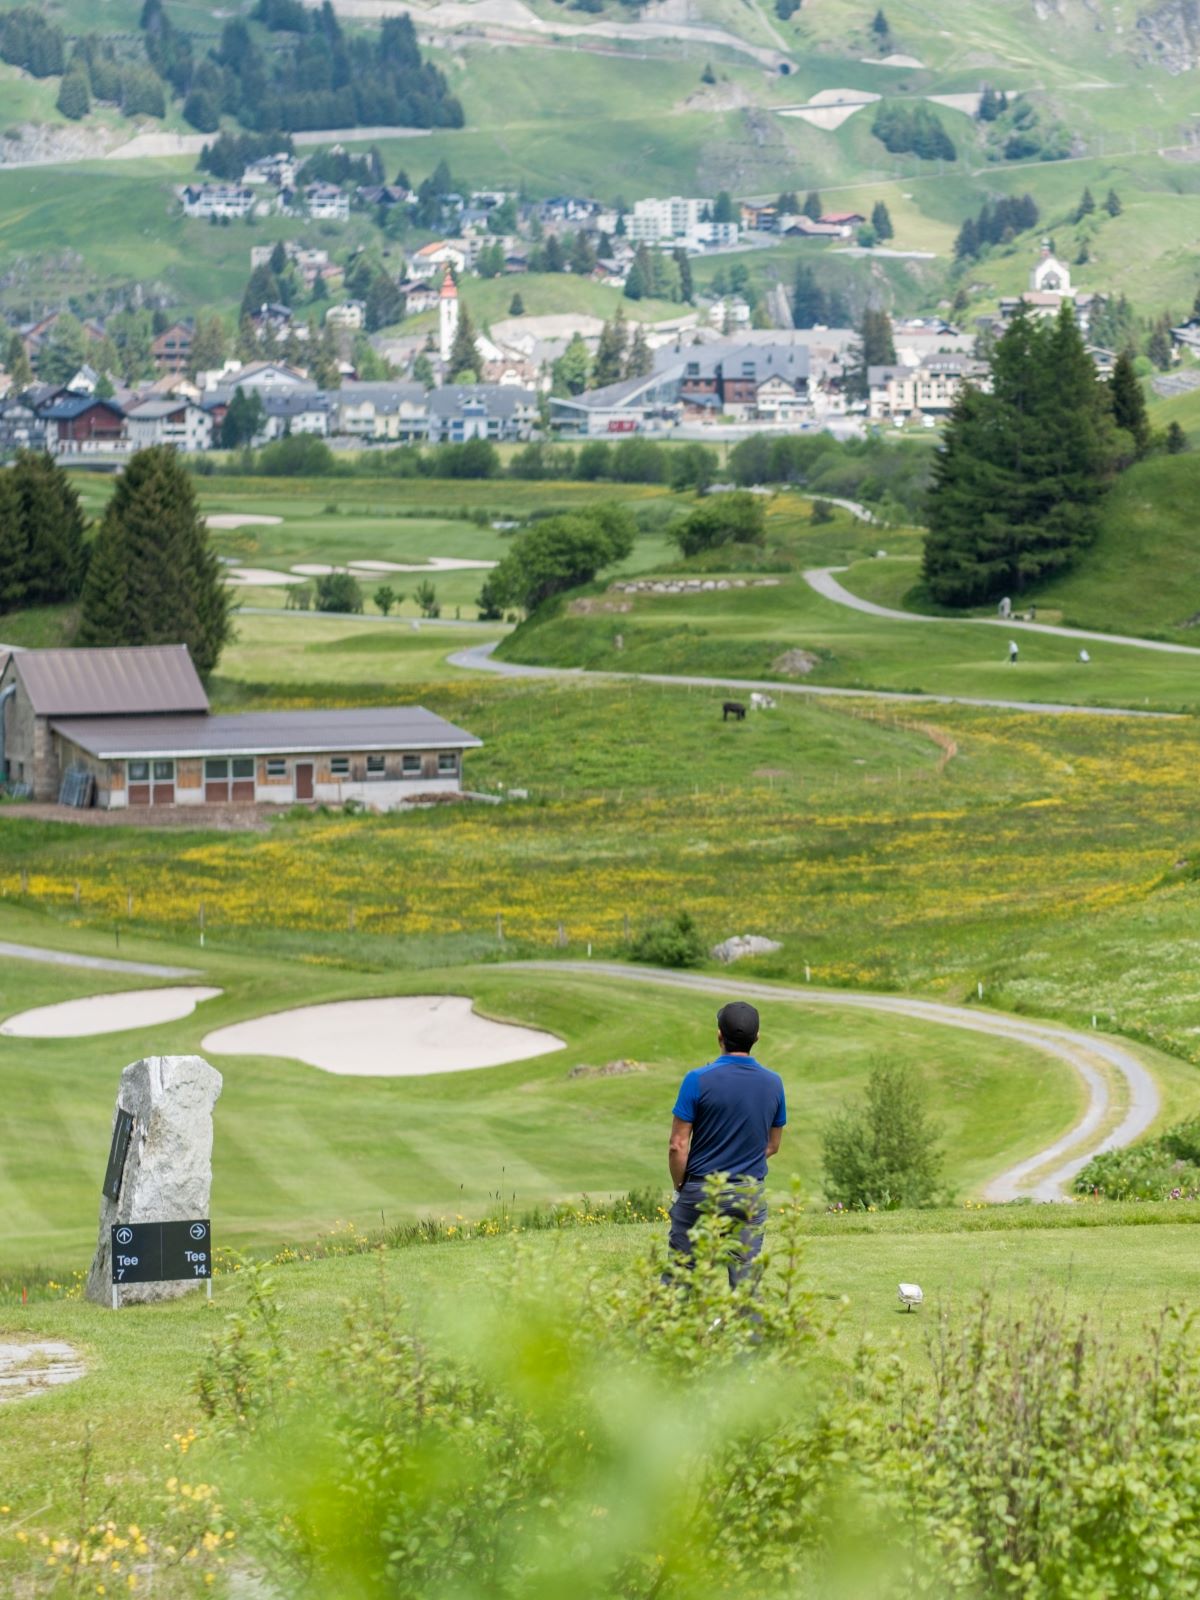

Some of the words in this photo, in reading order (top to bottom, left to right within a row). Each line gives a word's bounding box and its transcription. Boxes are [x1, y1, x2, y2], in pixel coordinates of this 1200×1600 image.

[117, 1255, 138, 1266] Tee
[184, 1251, 206, 1262] Tee
[117, 1269, 124, 1280] 7
[193, 1264, 206, 1275] 14
